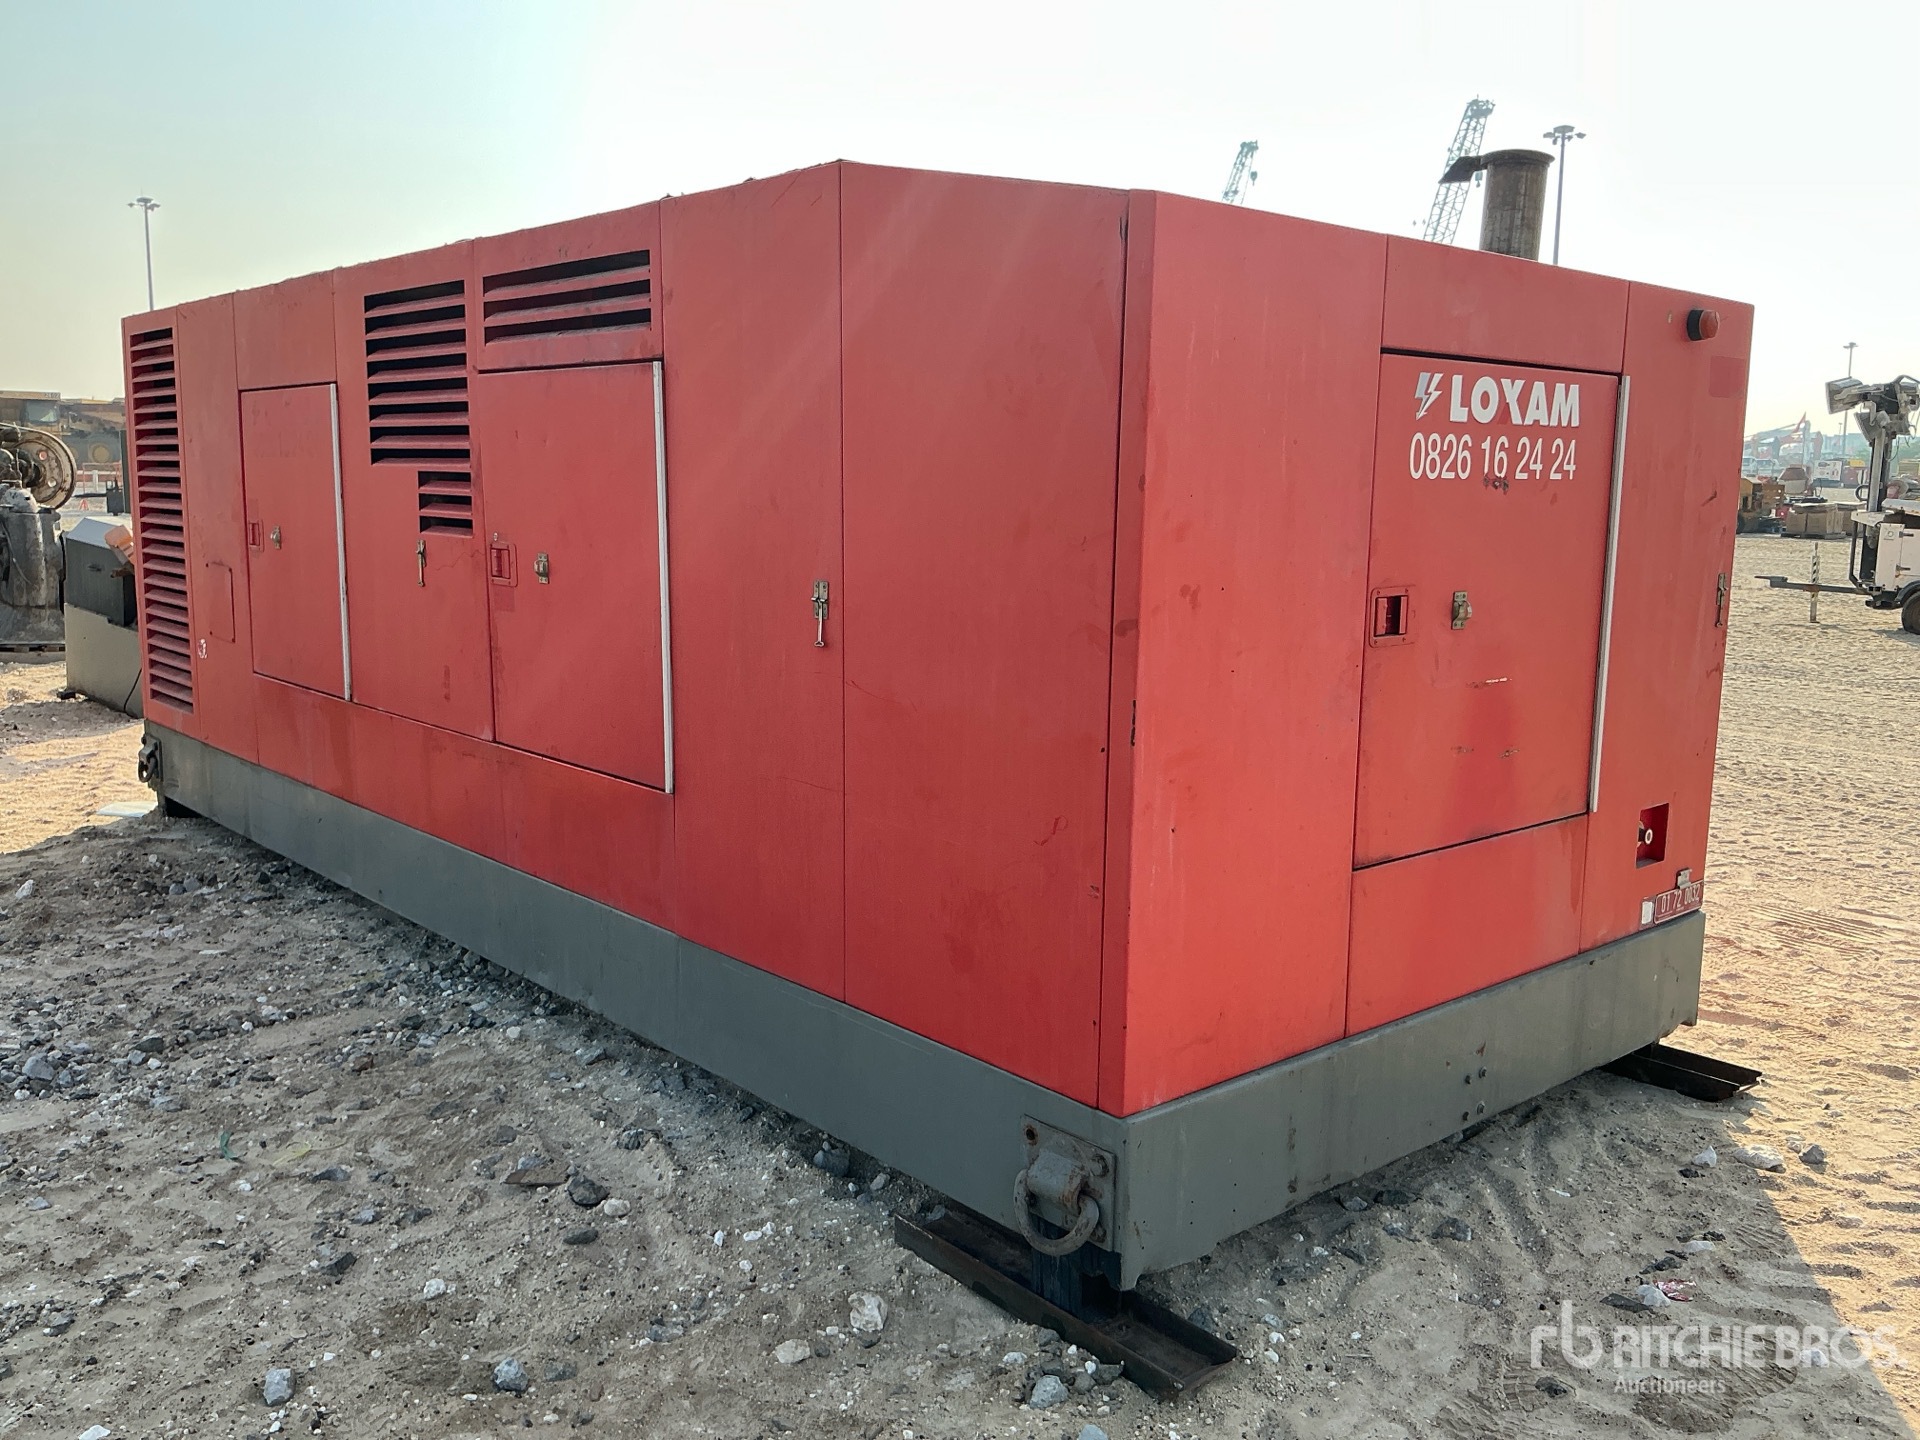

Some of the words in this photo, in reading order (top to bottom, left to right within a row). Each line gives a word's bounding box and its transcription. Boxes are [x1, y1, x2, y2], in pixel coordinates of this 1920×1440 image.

[1450, 375, 1579, 427] LOXAM
[1408, 432, 1472, 479] 0826
[1481, 436, 1509, 478] 16
[1515, 437, 1543, 480] 24
[1549, 438, 1576, 480] 24
[1673, 891, 1682, 909] 72
